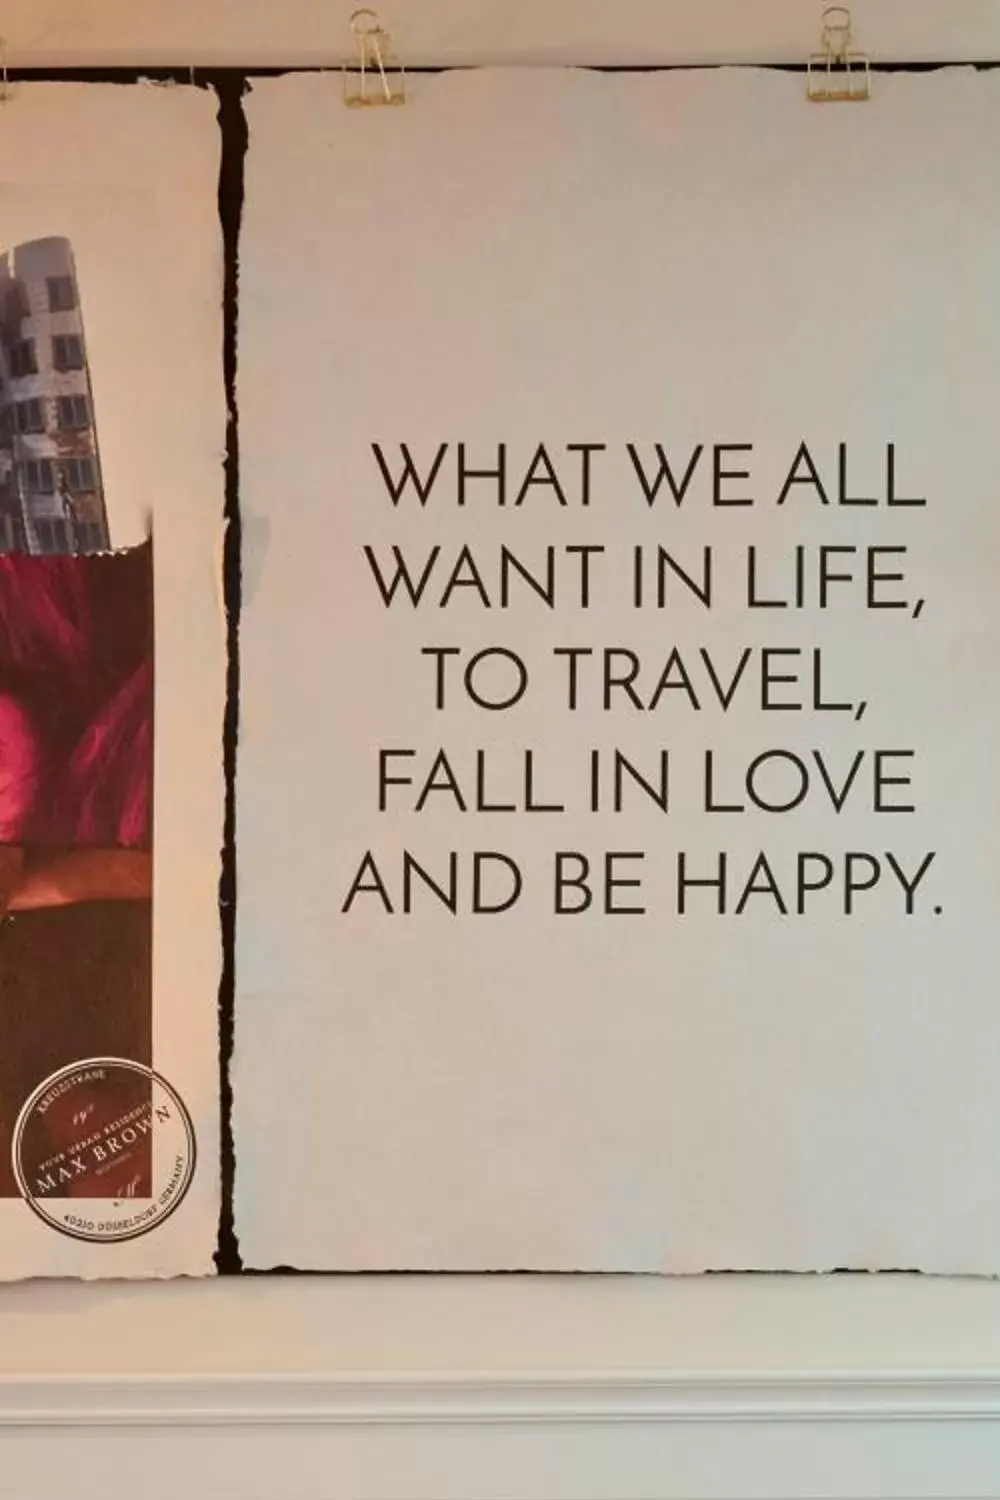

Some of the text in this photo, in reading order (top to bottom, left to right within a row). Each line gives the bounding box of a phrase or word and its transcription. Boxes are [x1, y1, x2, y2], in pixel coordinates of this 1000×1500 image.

[371, 441, 927, 508] WHAT WE ALL
[363, 543, 925, 619] WANT IN LIFE,
[420, 646, 867, 721] TO TRAVEL,
[378, 745, 915, 814] FALL IN LOVE
[341, 850, 943, 916] AND BE HAPPY.
[35, 1154, 88, 1194] MAX
[92, 1103, 172, 1162] BROWN
